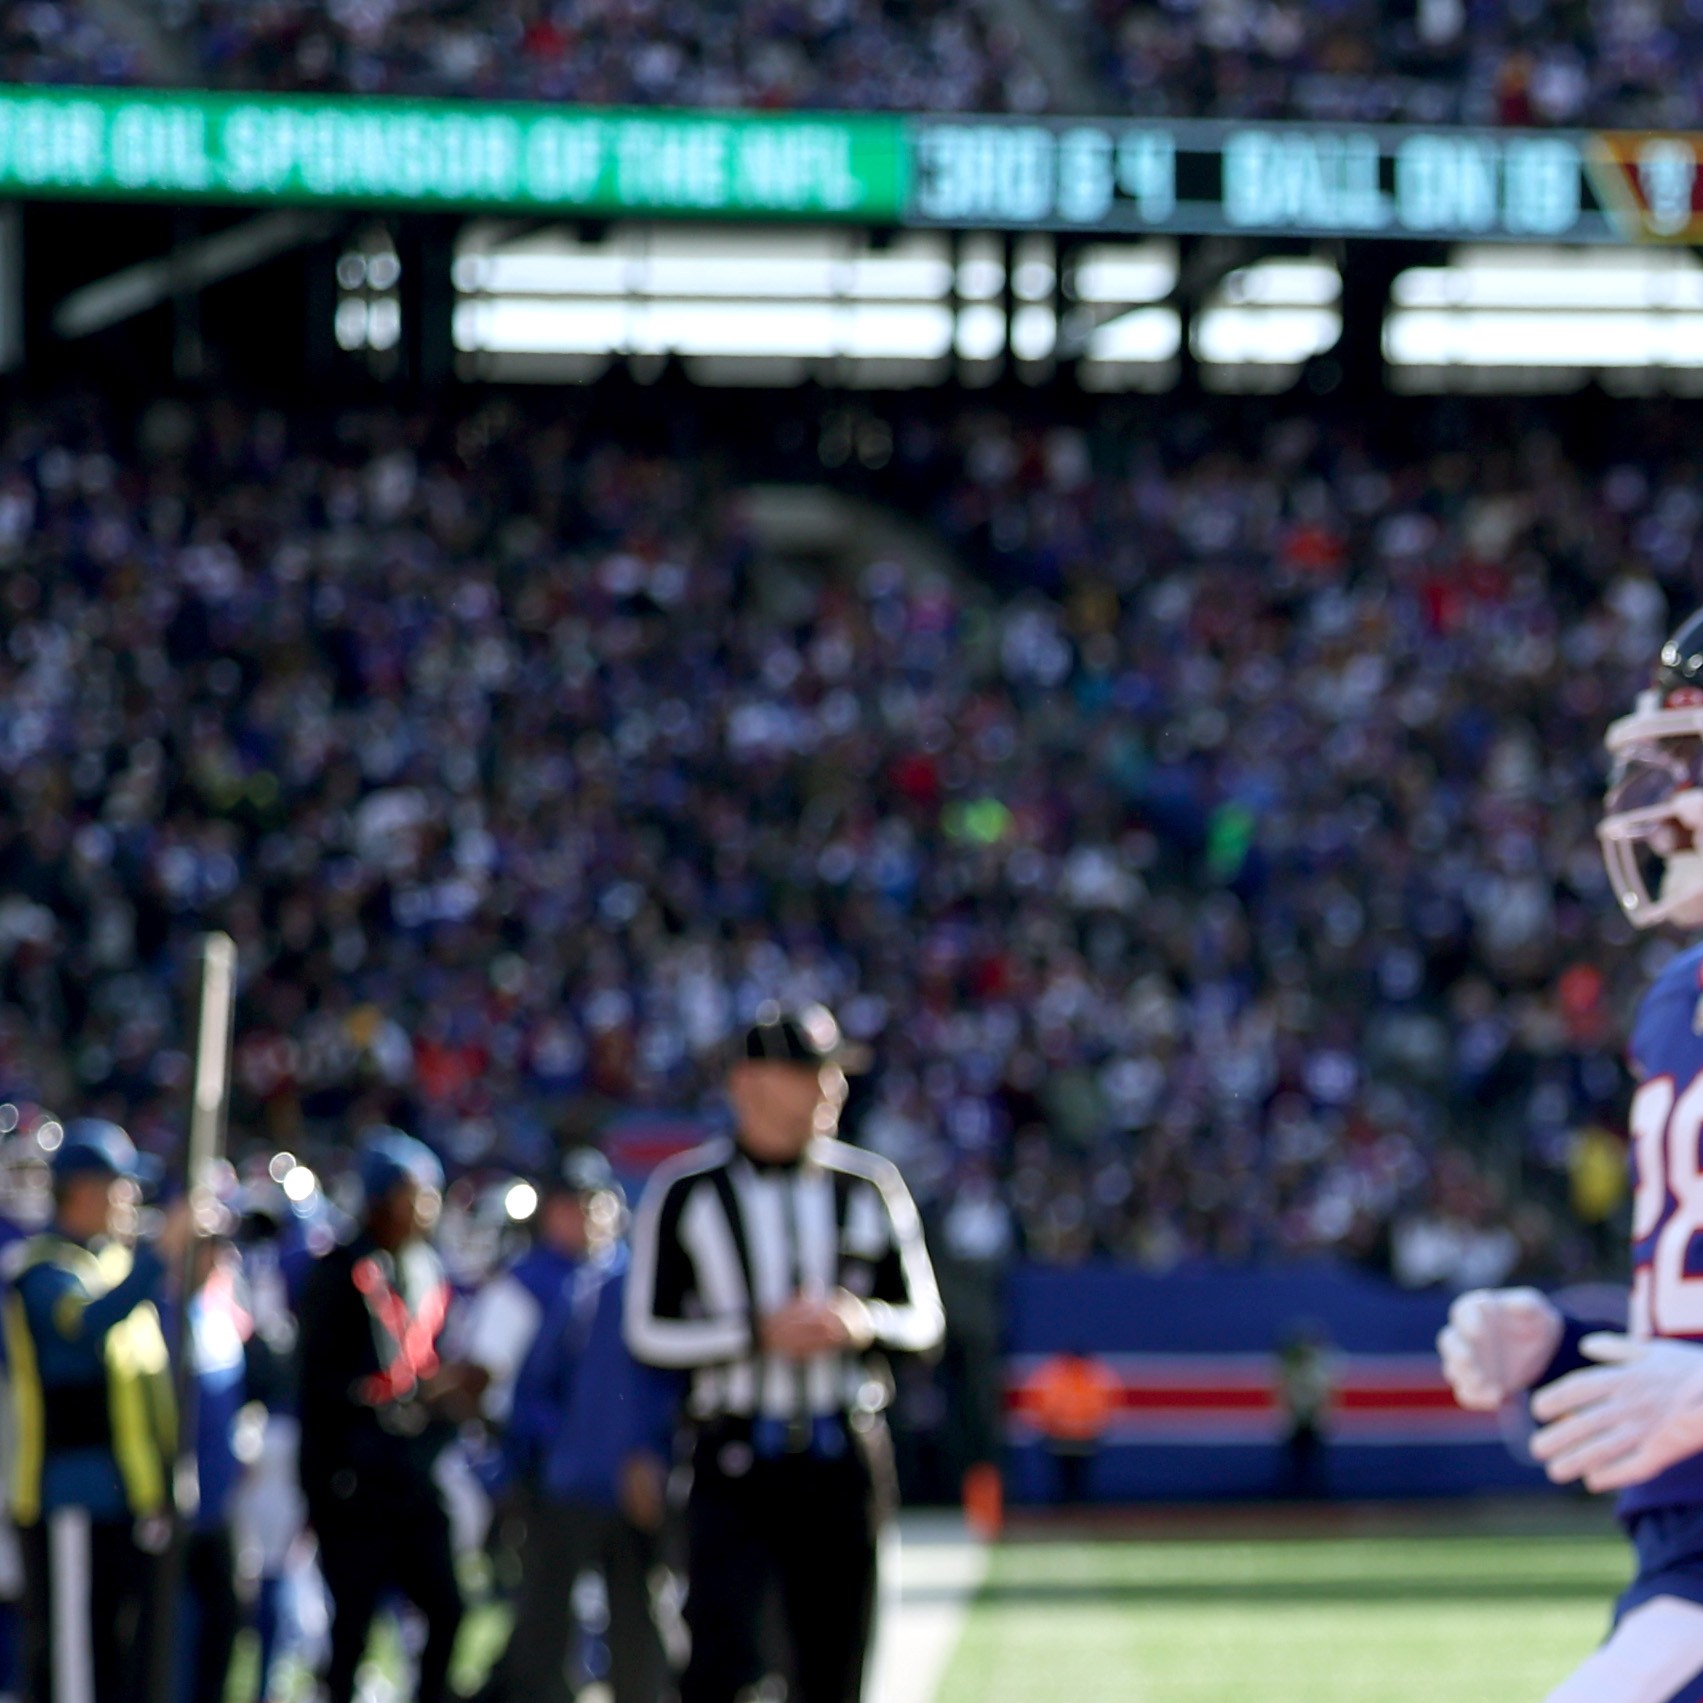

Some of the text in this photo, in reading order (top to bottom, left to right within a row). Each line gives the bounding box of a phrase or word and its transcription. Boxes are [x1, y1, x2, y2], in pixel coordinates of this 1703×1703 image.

[225, 104, 519, 200] SPONSOR
[527, 115, 601, 203] OF
[616, 117, 727, 210] THE
[738, 122, 868, 212] NFL
[1222, 129, 1394, 229] BALL
[1396, 134, 1495, 231] ON
